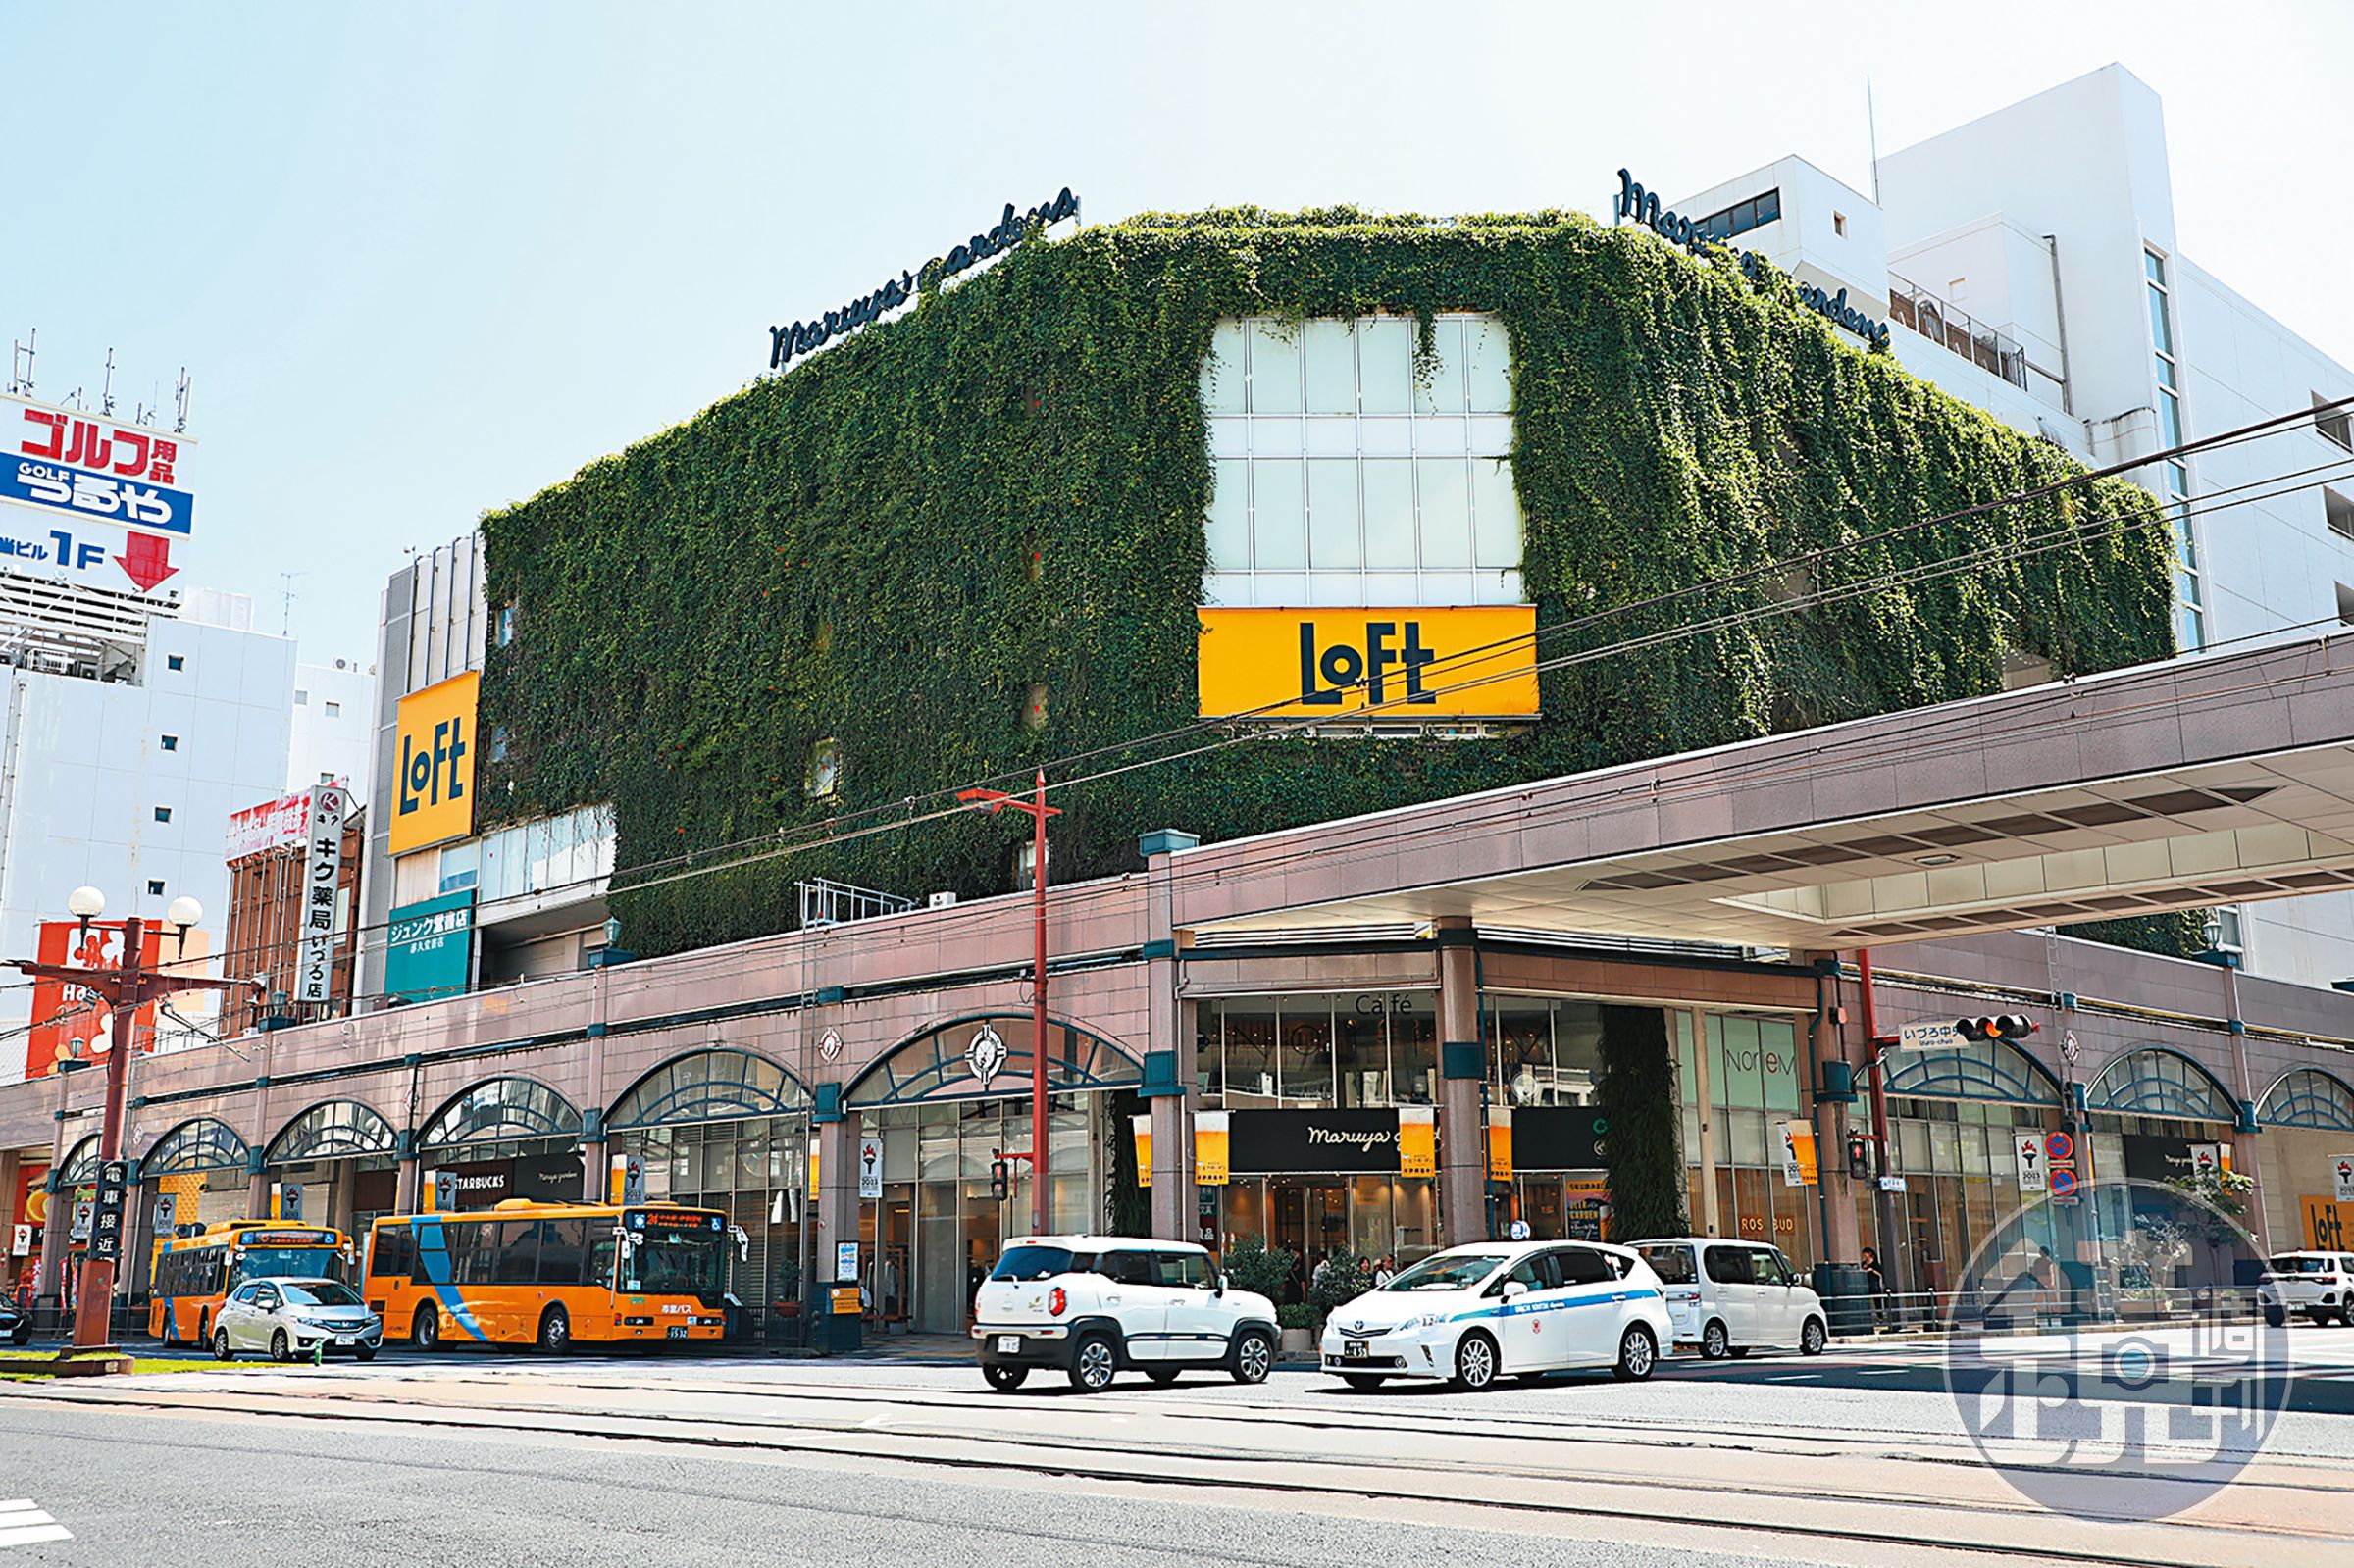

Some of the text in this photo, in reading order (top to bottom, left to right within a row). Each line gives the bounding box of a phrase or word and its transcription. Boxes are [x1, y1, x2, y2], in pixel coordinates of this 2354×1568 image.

[19, 461, 70, 482] GOLF
[17, 472, 173, 525] つるや
[50, 530, 106, 570] 1F
[62, 983, 87, 1002] Ha
[1355, 993, 1413, 1016] Café
[1307, 1126, 1391, 1153] Maruya
[96, 1165, 122, 1261] 電車接近
